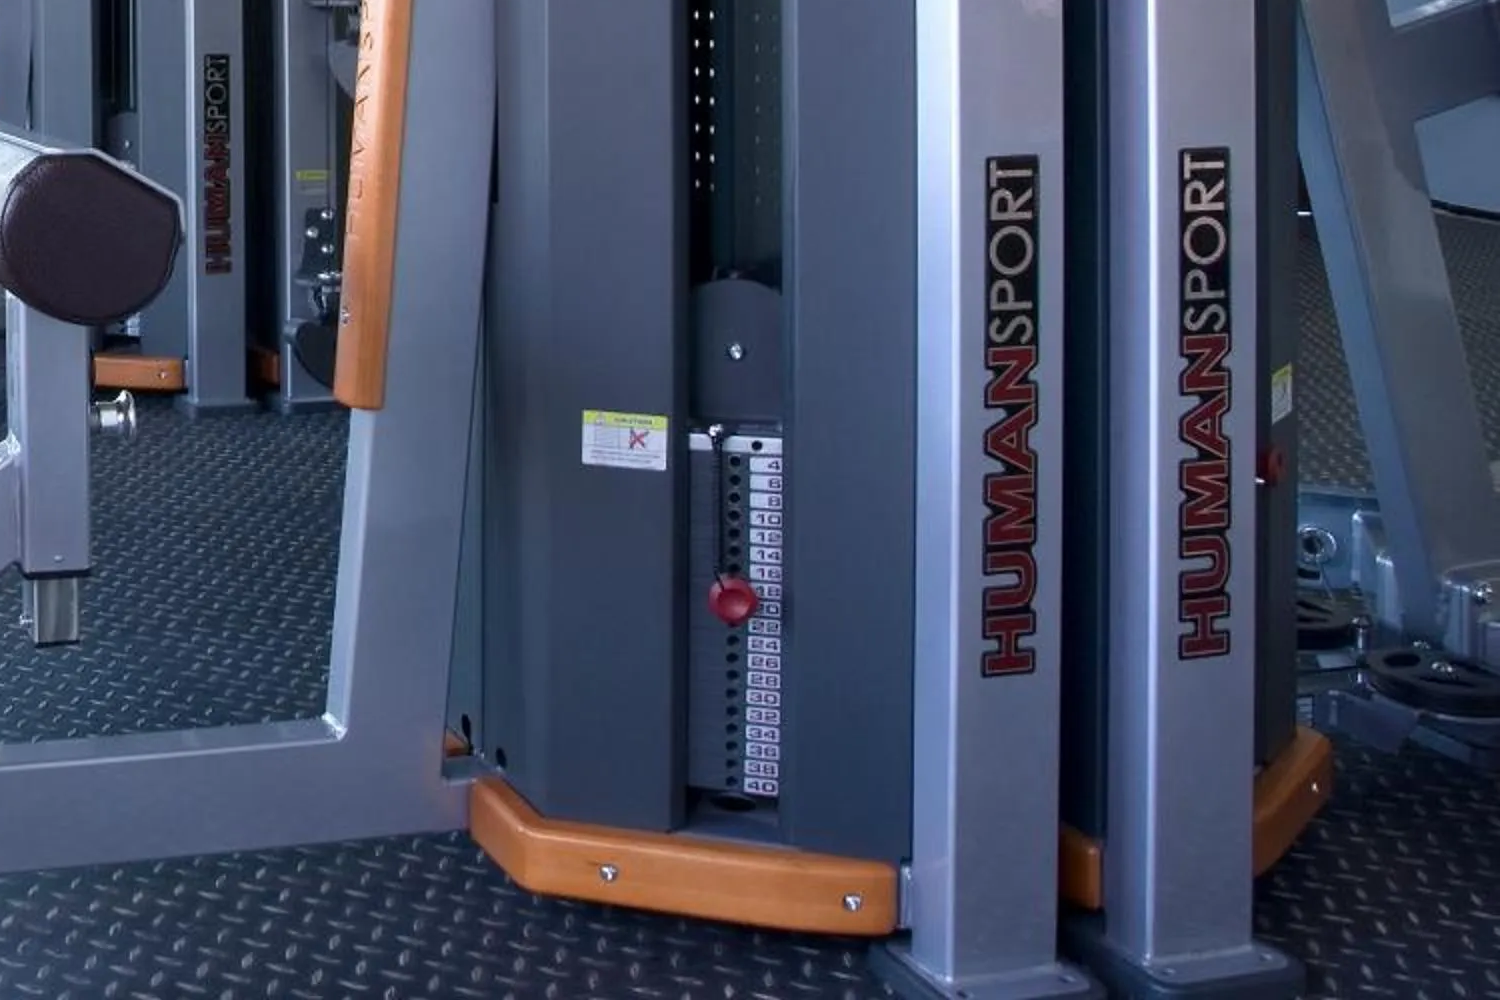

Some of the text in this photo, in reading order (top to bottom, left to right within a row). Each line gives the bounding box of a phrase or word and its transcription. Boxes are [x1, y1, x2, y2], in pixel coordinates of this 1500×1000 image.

[205, 54, 231, 274] HUMANSPORT
[1181, 147, 1231, 660] HUMANSPORT
[982, 155, 1039, 678] HUMANSPORT
[767, 460, 780, 471] 4
[756, 513, 780, 525] 10
[756, 531, 780, 543] 12
[756, 549, 780, 561] 14
[751, 638, 778, 650] 24
[750, 691, 777, 704] 30
[747, 780, 775, 793] 40
